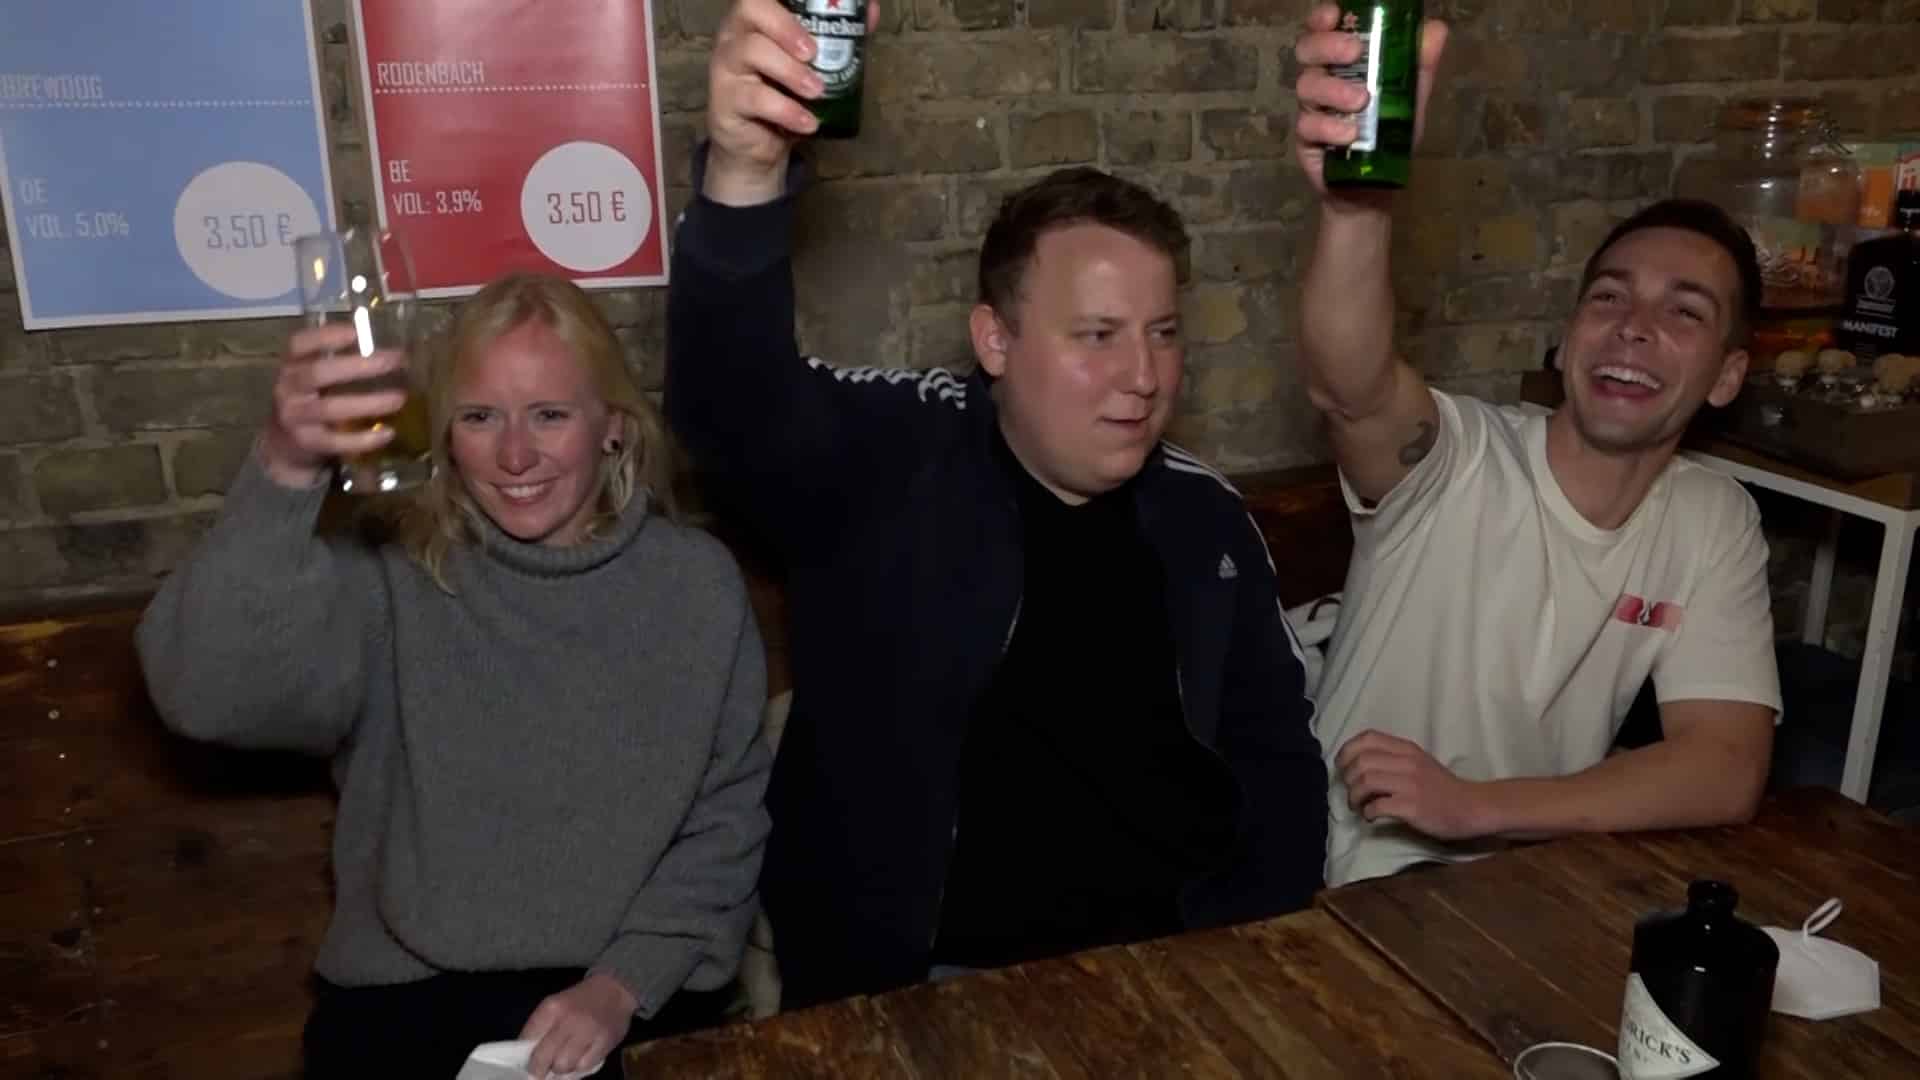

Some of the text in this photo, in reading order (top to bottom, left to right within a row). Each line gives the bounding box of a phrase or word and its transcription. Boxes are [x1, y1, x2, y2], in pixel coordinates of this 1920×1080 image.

[376, 61, 485, 85] RODENBACH
[389, 159, 412, 183] BE
[609, 188, 627, 222] €
[277, 212, 297, 247] €
[1843, 319, 1899, 338] MANIFEST
